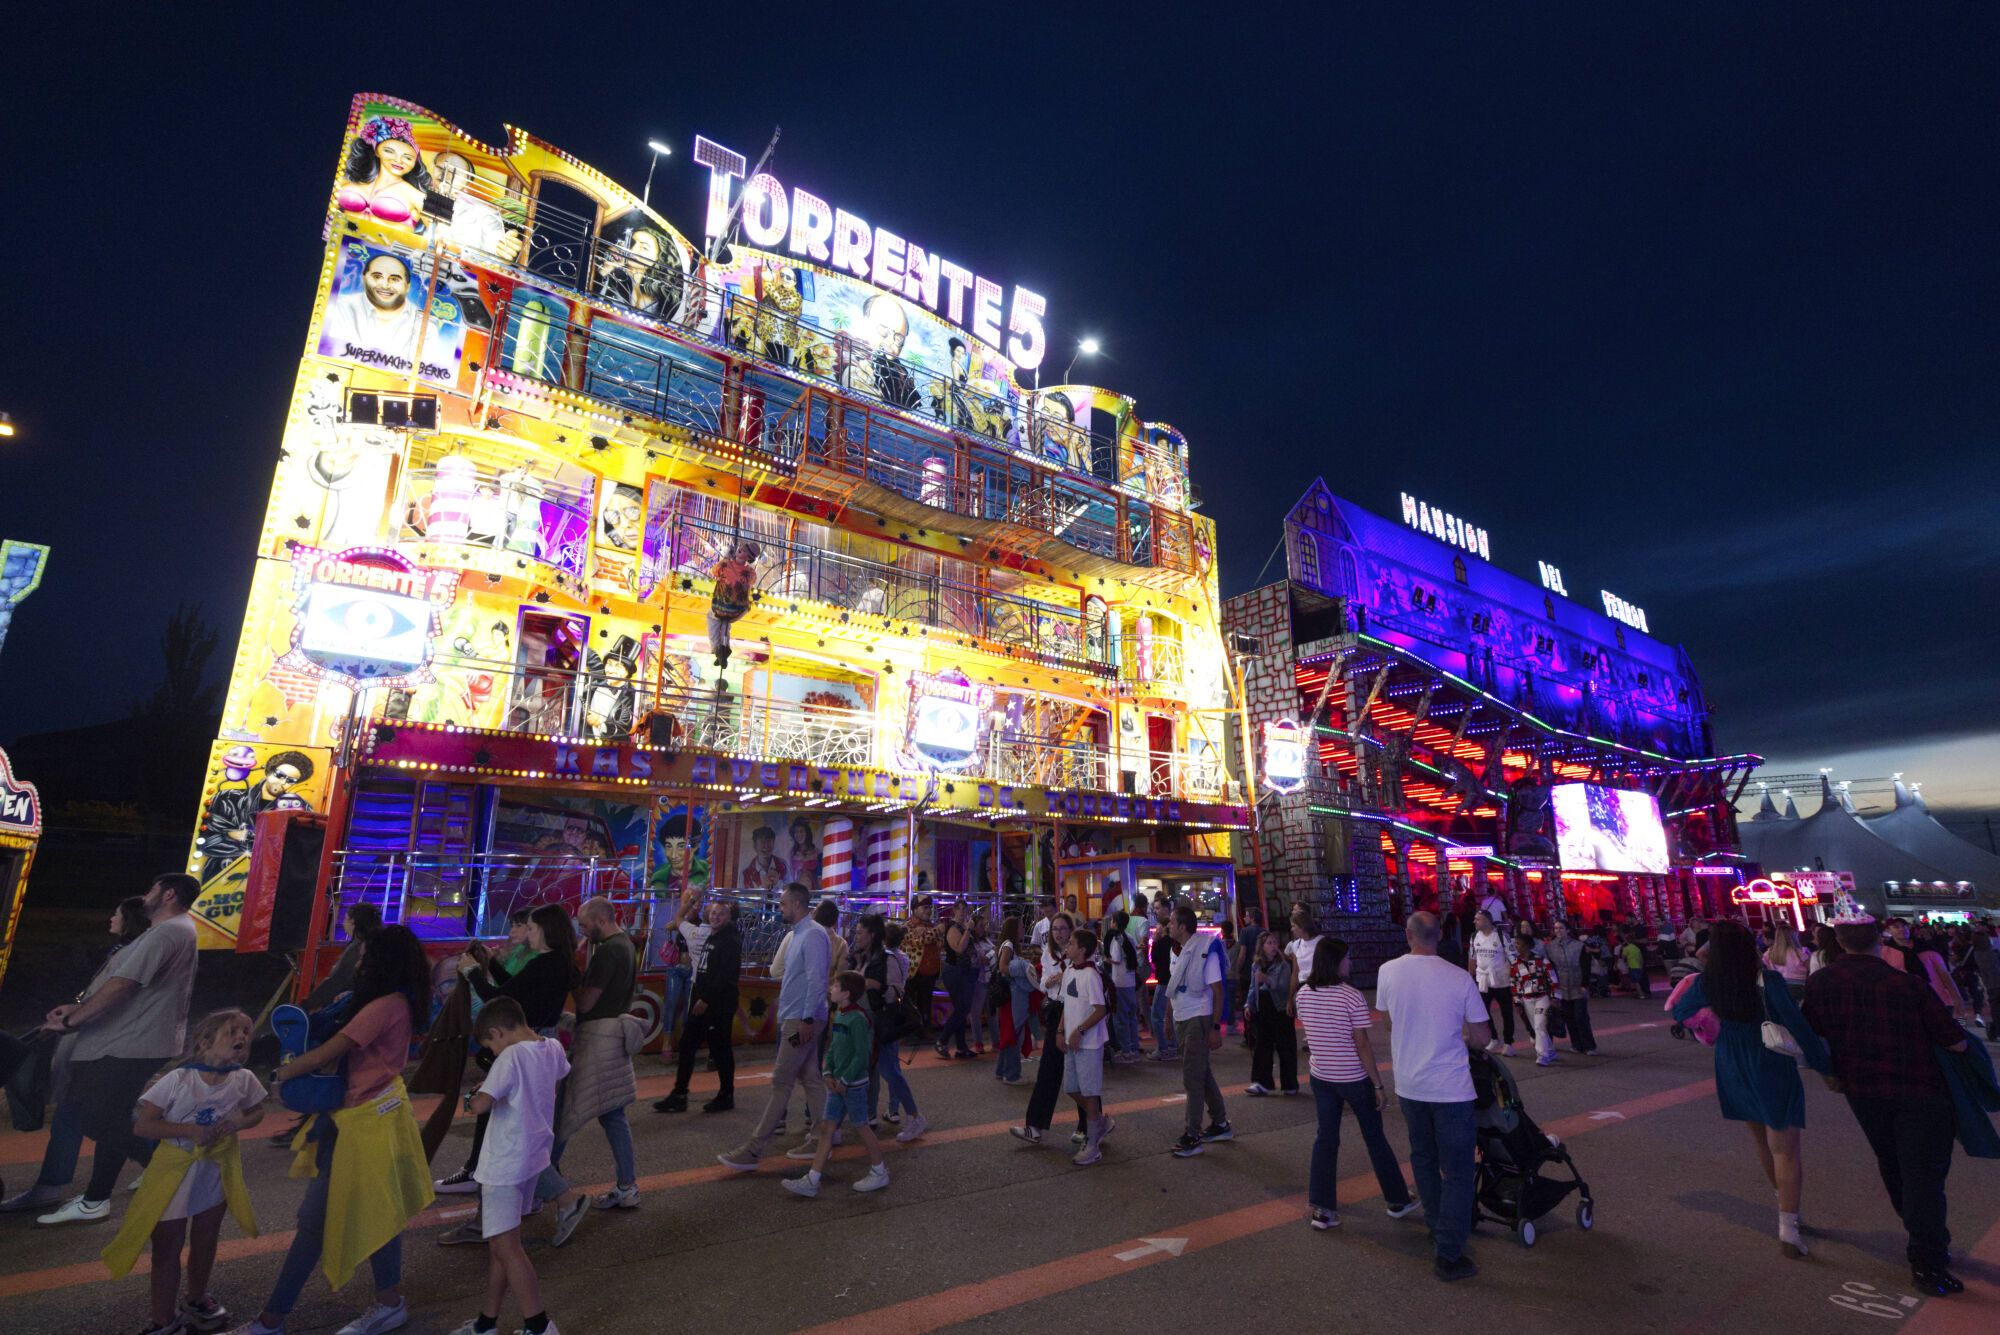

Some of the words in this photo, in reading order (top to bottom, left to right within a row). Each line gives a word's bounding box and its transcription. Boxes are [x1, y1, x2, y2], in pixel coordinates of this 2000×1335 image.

[693, 134, 1003, 350] TORRENTE
[1009, 285, 1048, 370] 5
[299, 552, 427, 599] TORRENTE
[430, 571, 453, 606] 5
[1400, 491, 1490, 561] MANSION
[1538, 560, 1568, 597] DEL
[554, 744, 653, 779] LAS
[977, 784, 1015, 809] DE
[1044, 791, 1181, 821] TORRENTE
